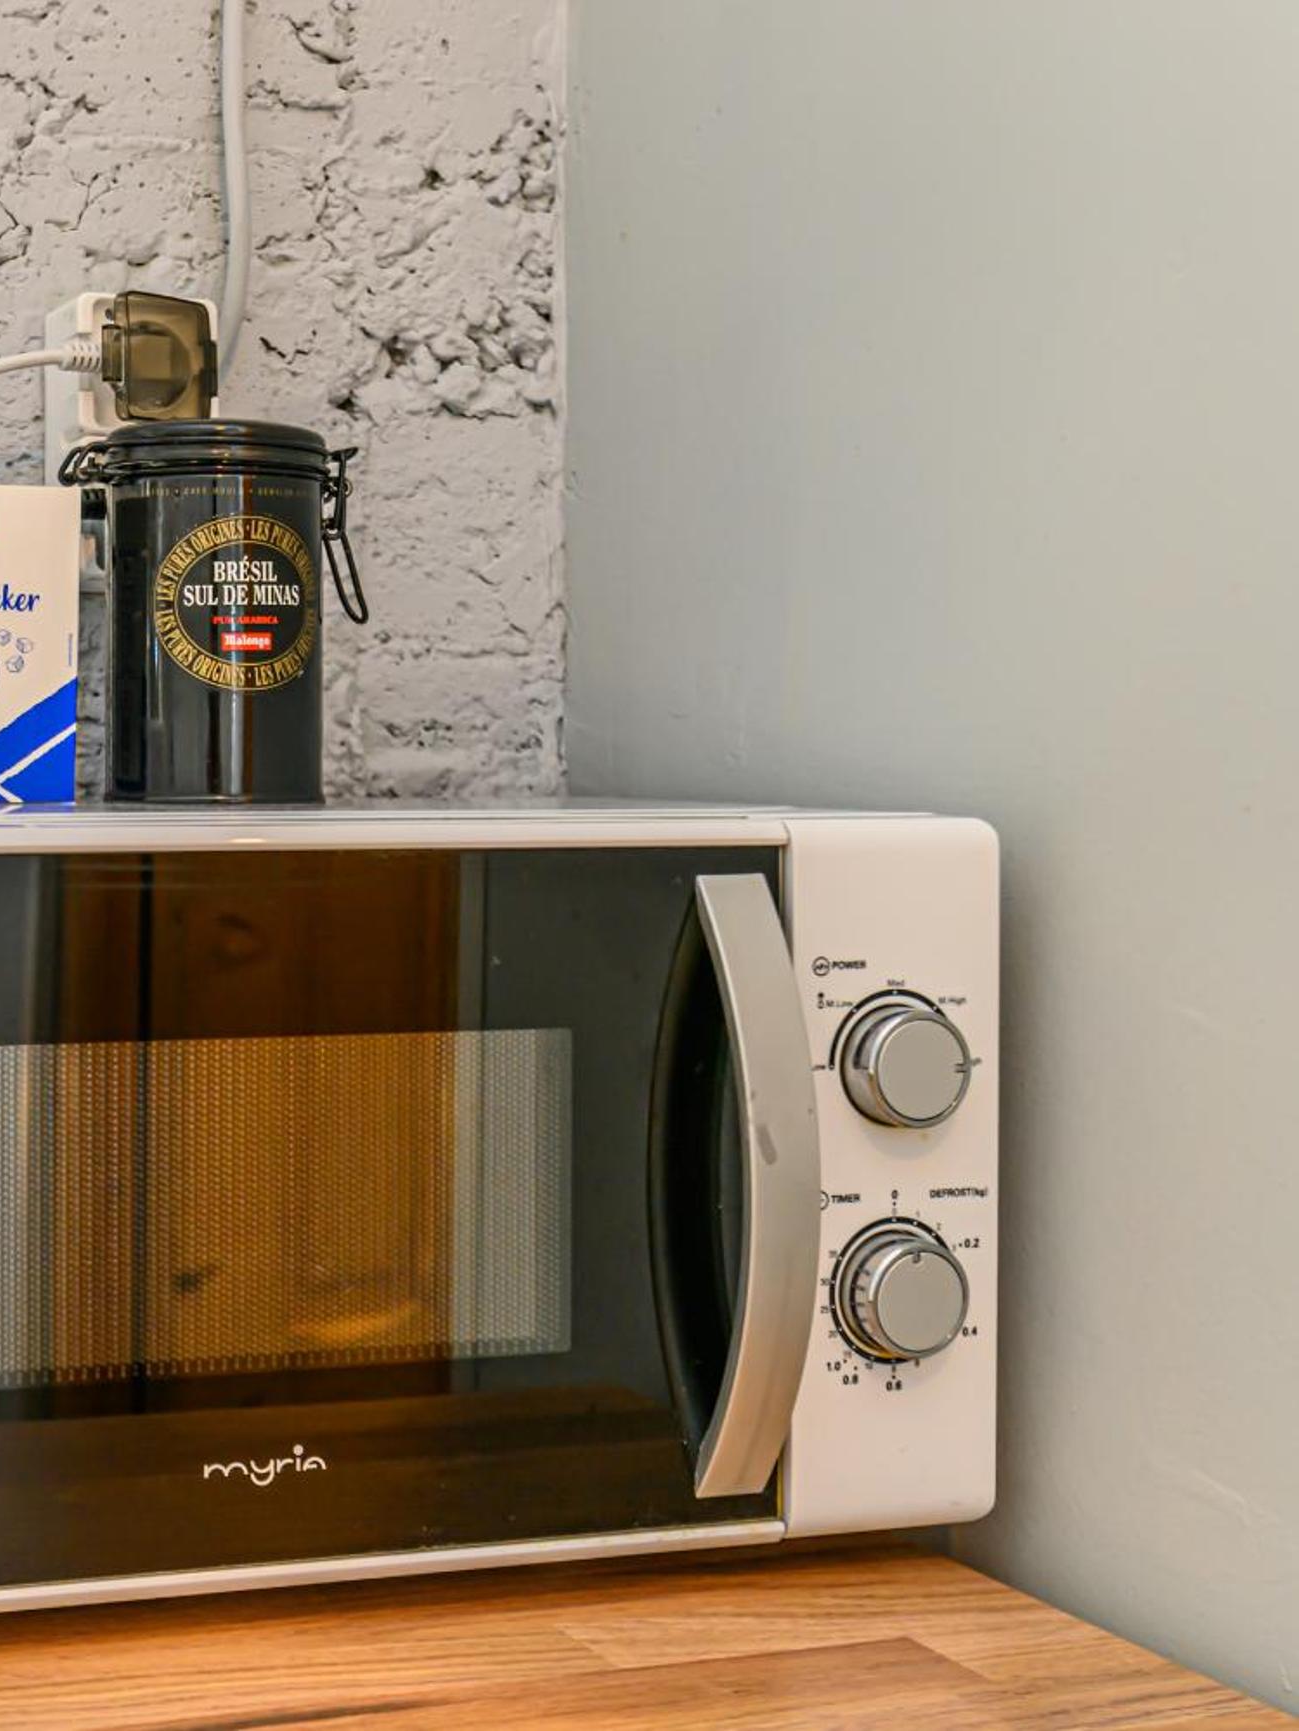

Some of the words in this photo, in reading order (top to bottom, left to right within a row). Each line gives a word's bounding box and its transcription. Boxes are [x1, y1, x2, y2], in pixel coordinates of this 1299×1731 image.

[251, 519, 270, 541] LES
[162, 543, 197, 581] PURES
[191, 519, 245, 551] ORIGINES
[213, 555, 278, 583] BRÉSIL
[183, 584, 218, 606] SUL
[223, 584, 249, 606] DE
[252, 584, 300, 606] MINAS
[164, 629, 198, 667] PURES
[832, 960, 866, 970] POWER
[831, 1193, 861, 1204] TIMER
[891, 1189, 899, 1199] 0
[964, 1238, 980, 1249] 0.2
[962, 1326, 978, 1337] 0.4
[826, 1361, 841, 1371] 1.0
[842, 1374, 859, 1385] 0.8
[203, 1444, 327, 1486] myria
